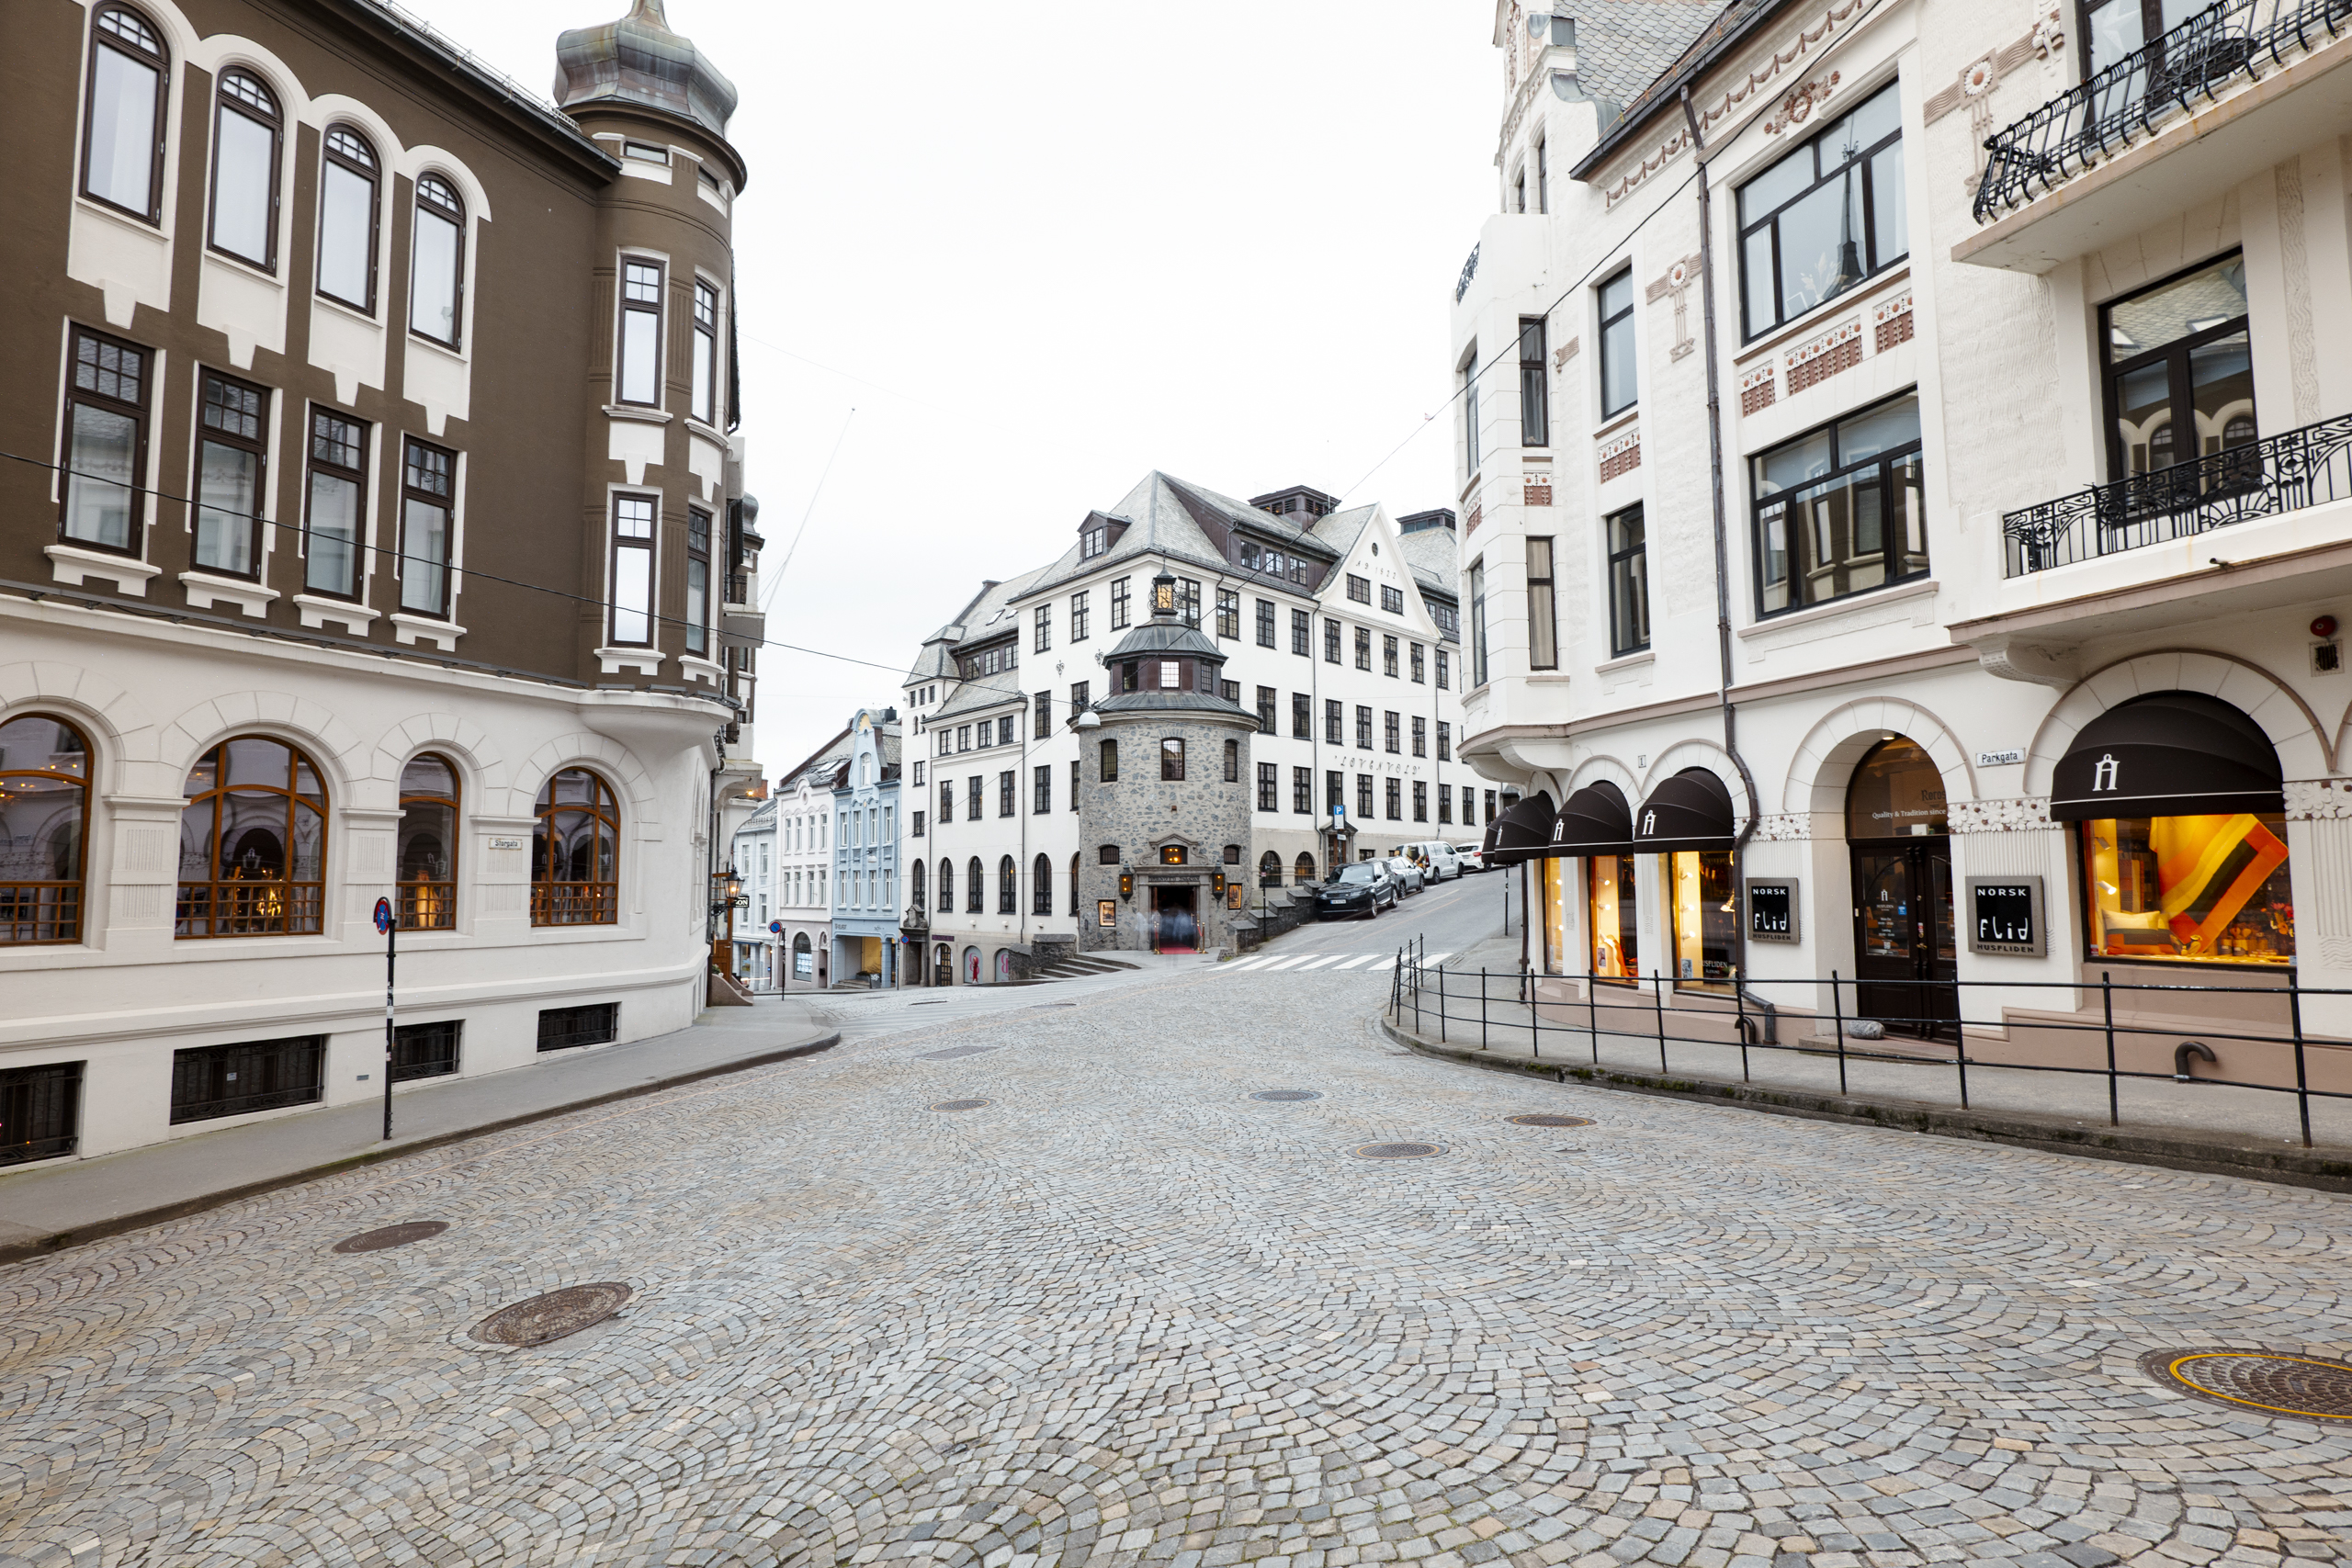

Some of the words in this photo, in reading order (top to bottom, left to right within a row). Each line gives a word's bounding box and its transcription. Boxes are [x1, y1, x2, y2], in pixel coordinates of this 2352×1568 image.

[1981, 751, 2018, 764] Parkgata
[1871, 810, 1894, 819] Quality
[495, 840, 518, 848] Storgata
[1977, 887, 2027, 897] NORSK
[1752, 932, 1792, 941] HUSFLIDEN
[1976, 943, 2034, 953] HUSFLIDEN
